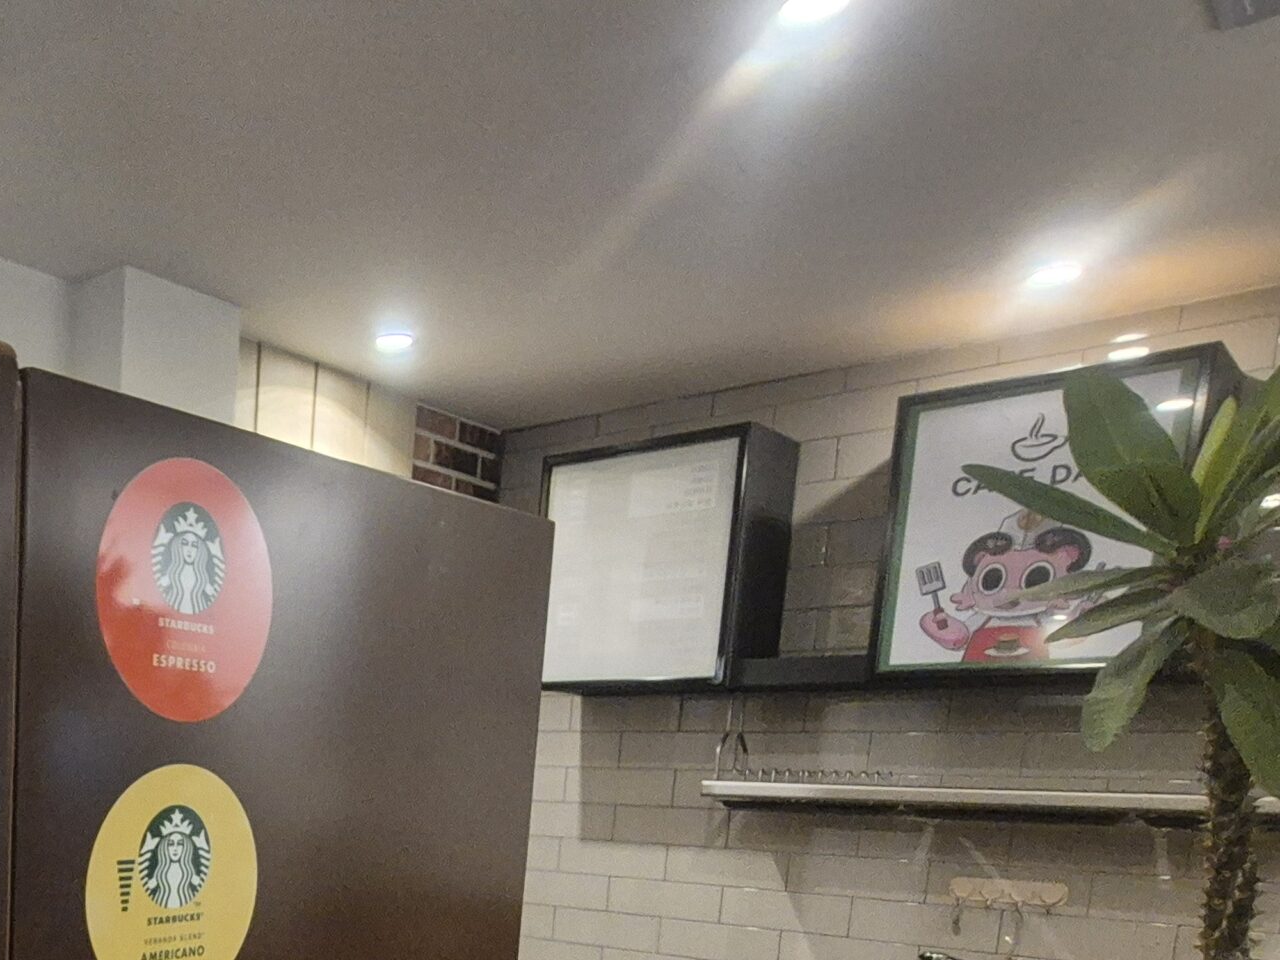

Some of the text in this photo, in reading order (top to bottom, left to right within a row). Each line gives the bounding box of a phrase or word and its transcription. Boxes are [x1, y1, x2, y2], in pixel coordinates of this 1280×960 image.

[952, 466, 1037, 497] CAE
[158, 617, 215, 635] STARBUCKS
[152, 652, 217, 673] ESPRESSO
[147, 912, 204, 926] STARBUCKS
